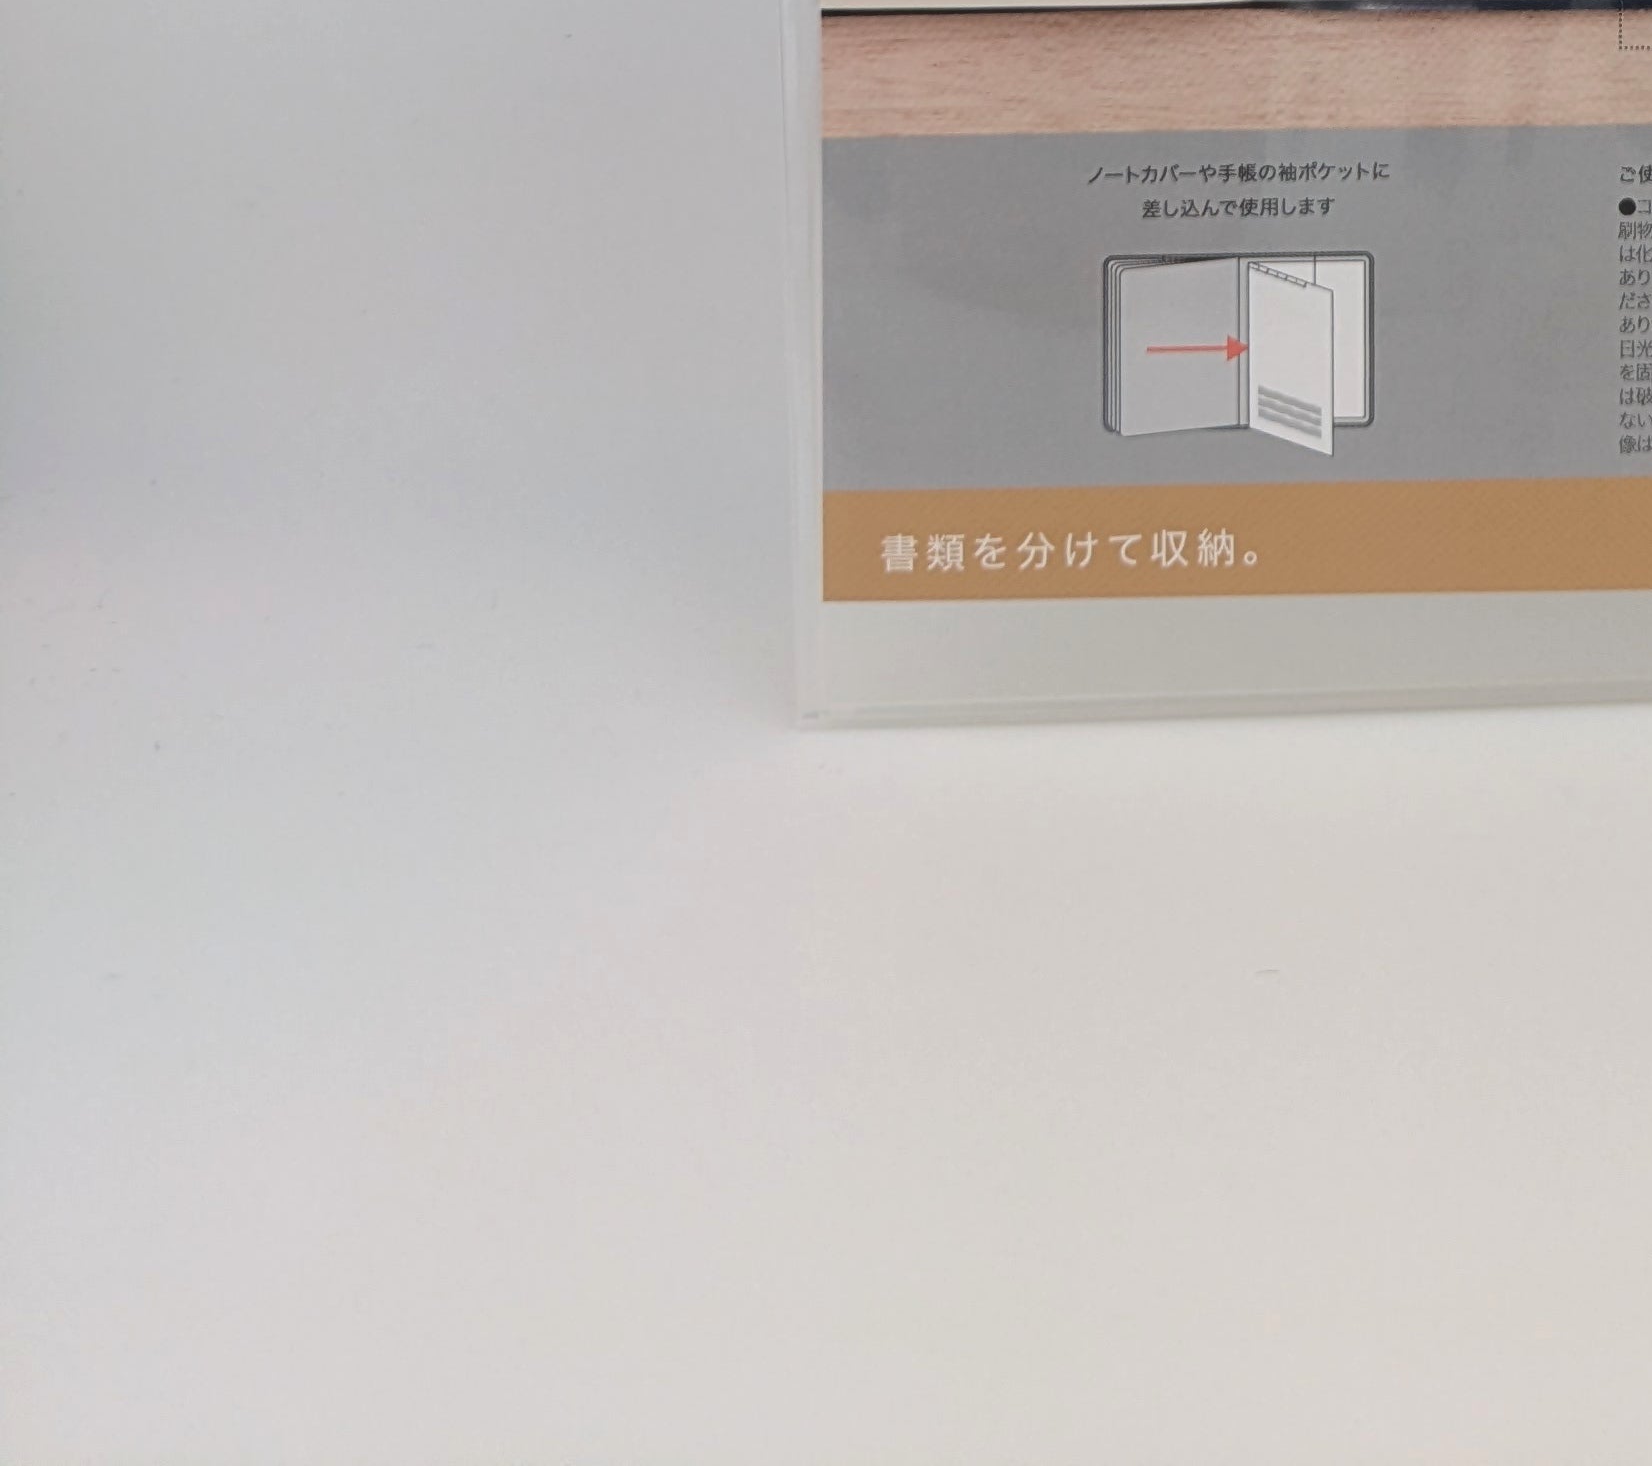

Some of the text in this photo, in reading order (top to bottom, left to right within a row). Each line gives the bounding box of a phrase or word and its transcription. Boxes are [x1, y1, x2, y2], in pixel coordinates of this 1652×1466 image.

[1087, 161, 1391, 186] ノートカバーや手帳の袖ポケットに
[1141, 197, 1336, 219] 差し込んで使用します
[880, 528, 1260, 573] 書類を分けて収納。
